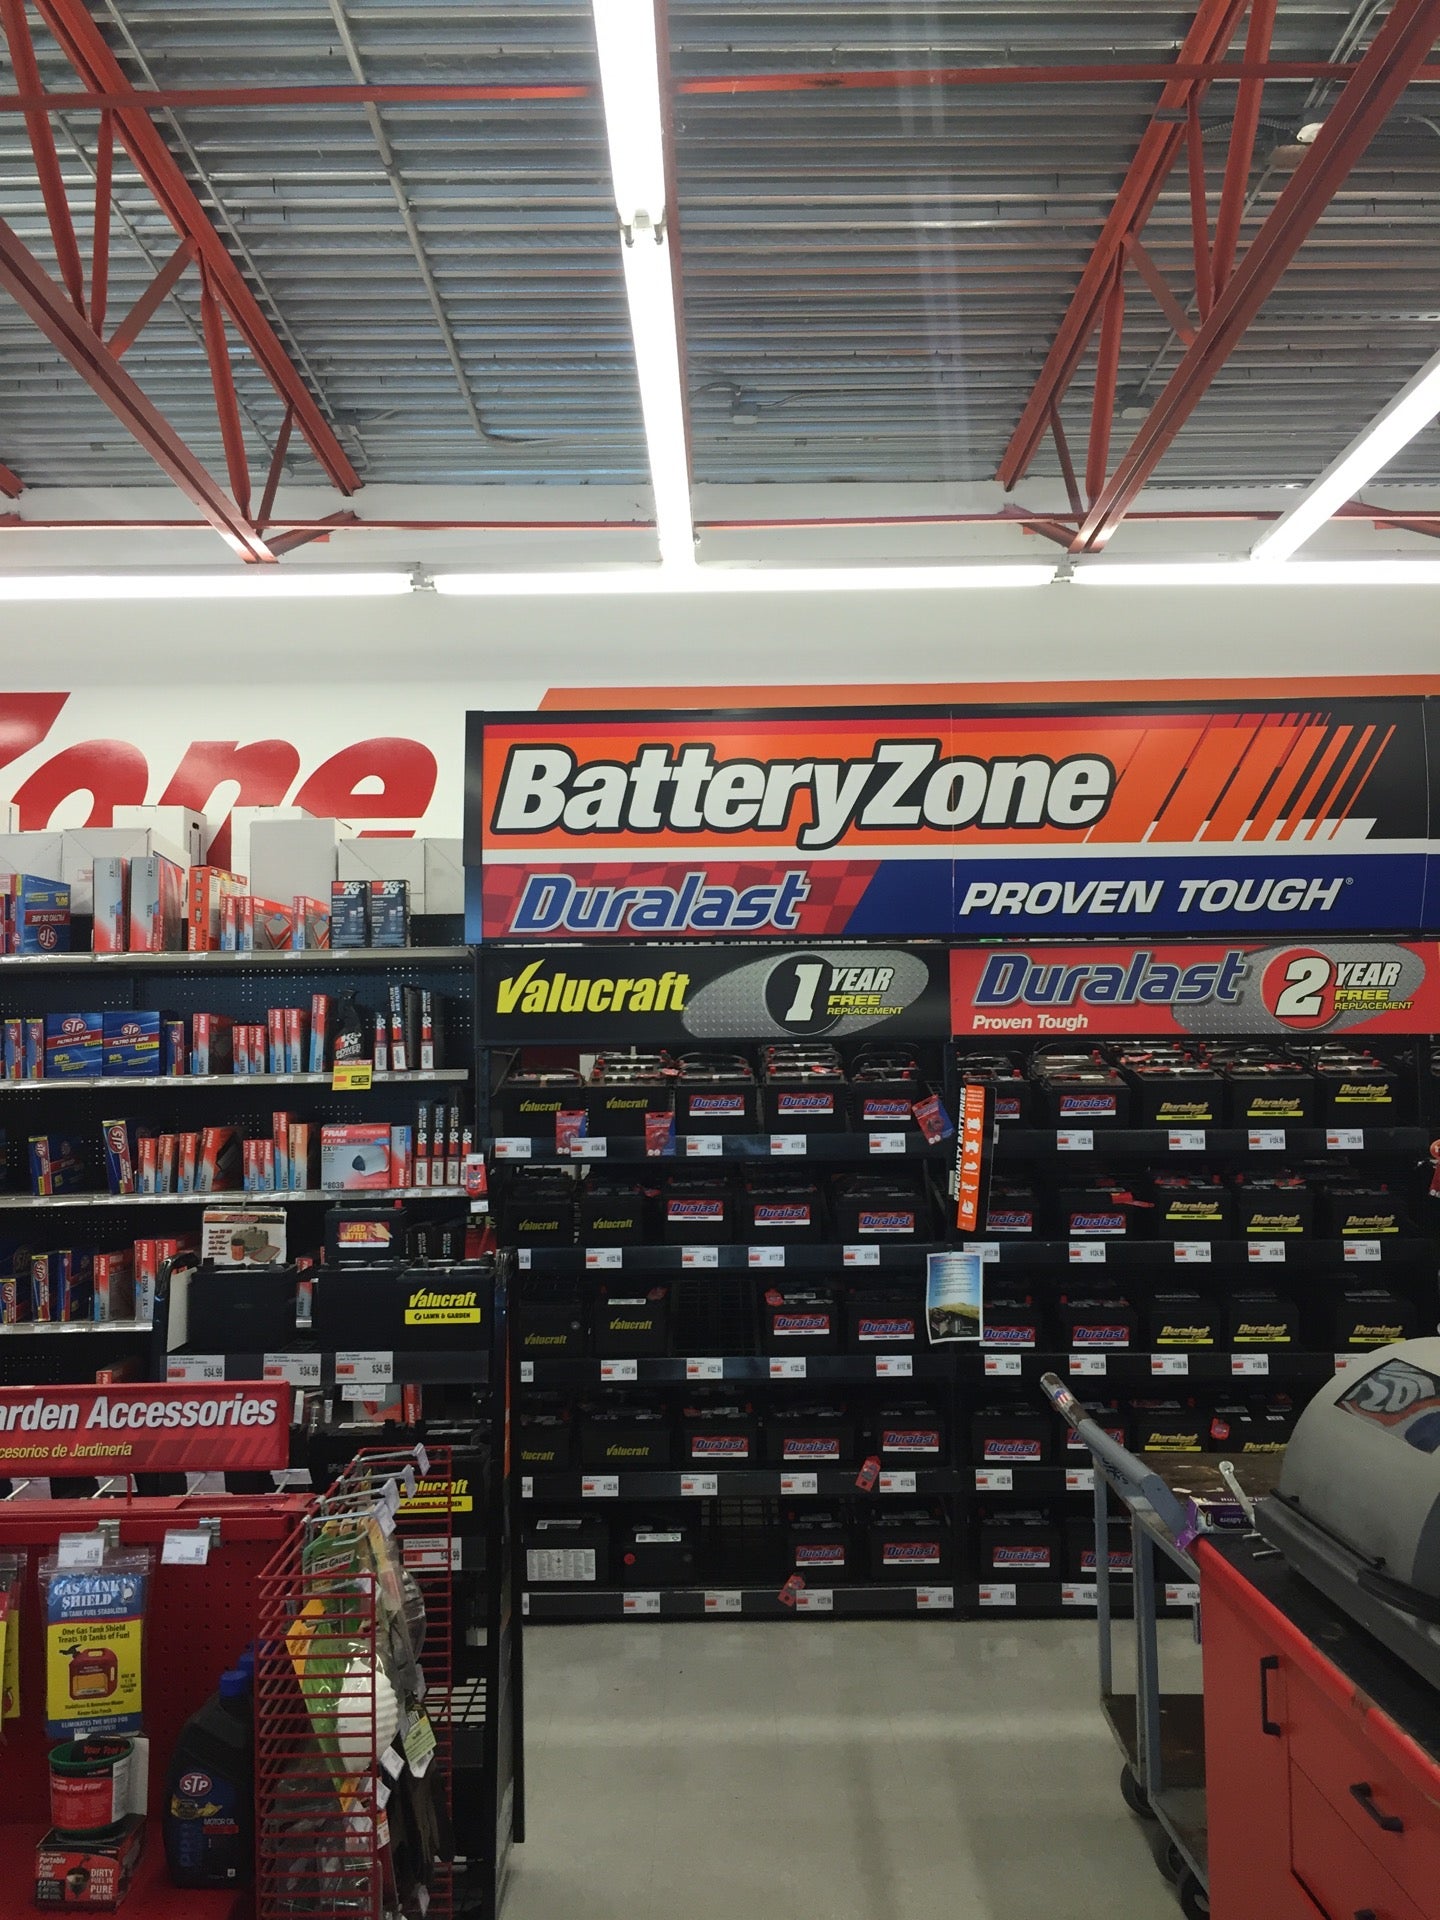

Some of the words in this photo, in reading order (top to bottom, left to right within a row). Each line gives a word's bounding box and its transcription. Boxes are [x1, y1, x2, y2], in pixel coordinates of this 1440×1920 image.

[492, 741, 1113, 847] BatteryZone
[509, 870, 812, 933] Duralast
[959, 880, 1165, 915] PROVEN
[39, 928, 56, 947] STP
[828, 967, 895, 992] YEAR
[972, 950, 1248, 1006] Duralast
[1334, 962, 1401, 987] YEAR
[496, 958, 690, 1014] Valucraft
[1274, 957, 1331, 1017] 2
[784, 963, 823, 1022] 1
[1334, 989, 1390, 1001] FREE
[827, 994, 881, 1006] FREE
[1333, 1001, 1414, 1011] REPLACEMENT
[826, 1006, 903, 1016] REPLACEMENT
[64, 1020, 85, 1033] STP
[972, 1014, 1032, 1030] Proven
[1037, 1014, 1089, 1031] Tough
[123, 1026, 139, 1034] STP
[56, 1037, 72, 1045] FILTRO
[112, 1038, 129, 1046] FILTRO
[606, 1097, 648, 1109] Valucraft
[692, 1097, 741, 1109] Duralast
[781, 1096, 831, 1107] Duralast
[1063, 1098, 1112, 1110] Duralast
[866, 1103, 909, 1113] Duralast
[957, 1087, 966, 1144] BATTERIES
[111, 1126, 125, 1153] STP
[323, 1129, 347, 1138] FRAM
[954, 1145, 963, 1201] SPECIALTY
[671, 1203, 719, 1213] Duralast
[758, 1206, 806, 1218] Duralast
[862, 1215, 910, 1226] Duralast
[989, 1214, 1029, 1224] uralast
[1073, 1216, 1123, 1227] Duralast
[346, 1223, 367, 1234] USED
[34, 1262, 47, 1280] STP
[409, 1288, 477, 1307] Valucraft
[777, 1316, 826, 1328] Duralast
[862, 1322, 912, 1333] Duralast
[983, 1329, 1031, 1340] Duralast
[1076, 1328, 1125, 1339] Duralast
[203, 1366, 223, 1378] $34.99
[300, 1365, 319, 1377] $34.99
[371, 1363, 391, 1375] $34.99
[85, 1393, 278, 1429] Accessories
[696, 1439, 744, 1450] Duralast
[887, 1434, 936, 1444] Duralast
[52, 1444, 67, 1458] de
[70, 1442, 132, 1458] Jardinería
[787, 1440, 836, 1452] Duralast
[986, 1442, 1038, 1454] Duralast
[313, 1560, 330, 1573] TIRE
[54, 1581, 81, 1596] GAS
[83, 1579, 121, 1594] TANK
[62, 1594, 112, 1610] SHIELD
[62, 1628, 75, 1636] One
[89, 1625, 104, 1633] Tank
[58, 1635, 78, 1643] Treats
[116, 1631, 130, 1639] Fuel
[183, 1775, 208, 1793] STP
[90, 1868, 114, 1877] DIRTY
[90, 1885, 113, 1893] PURE
